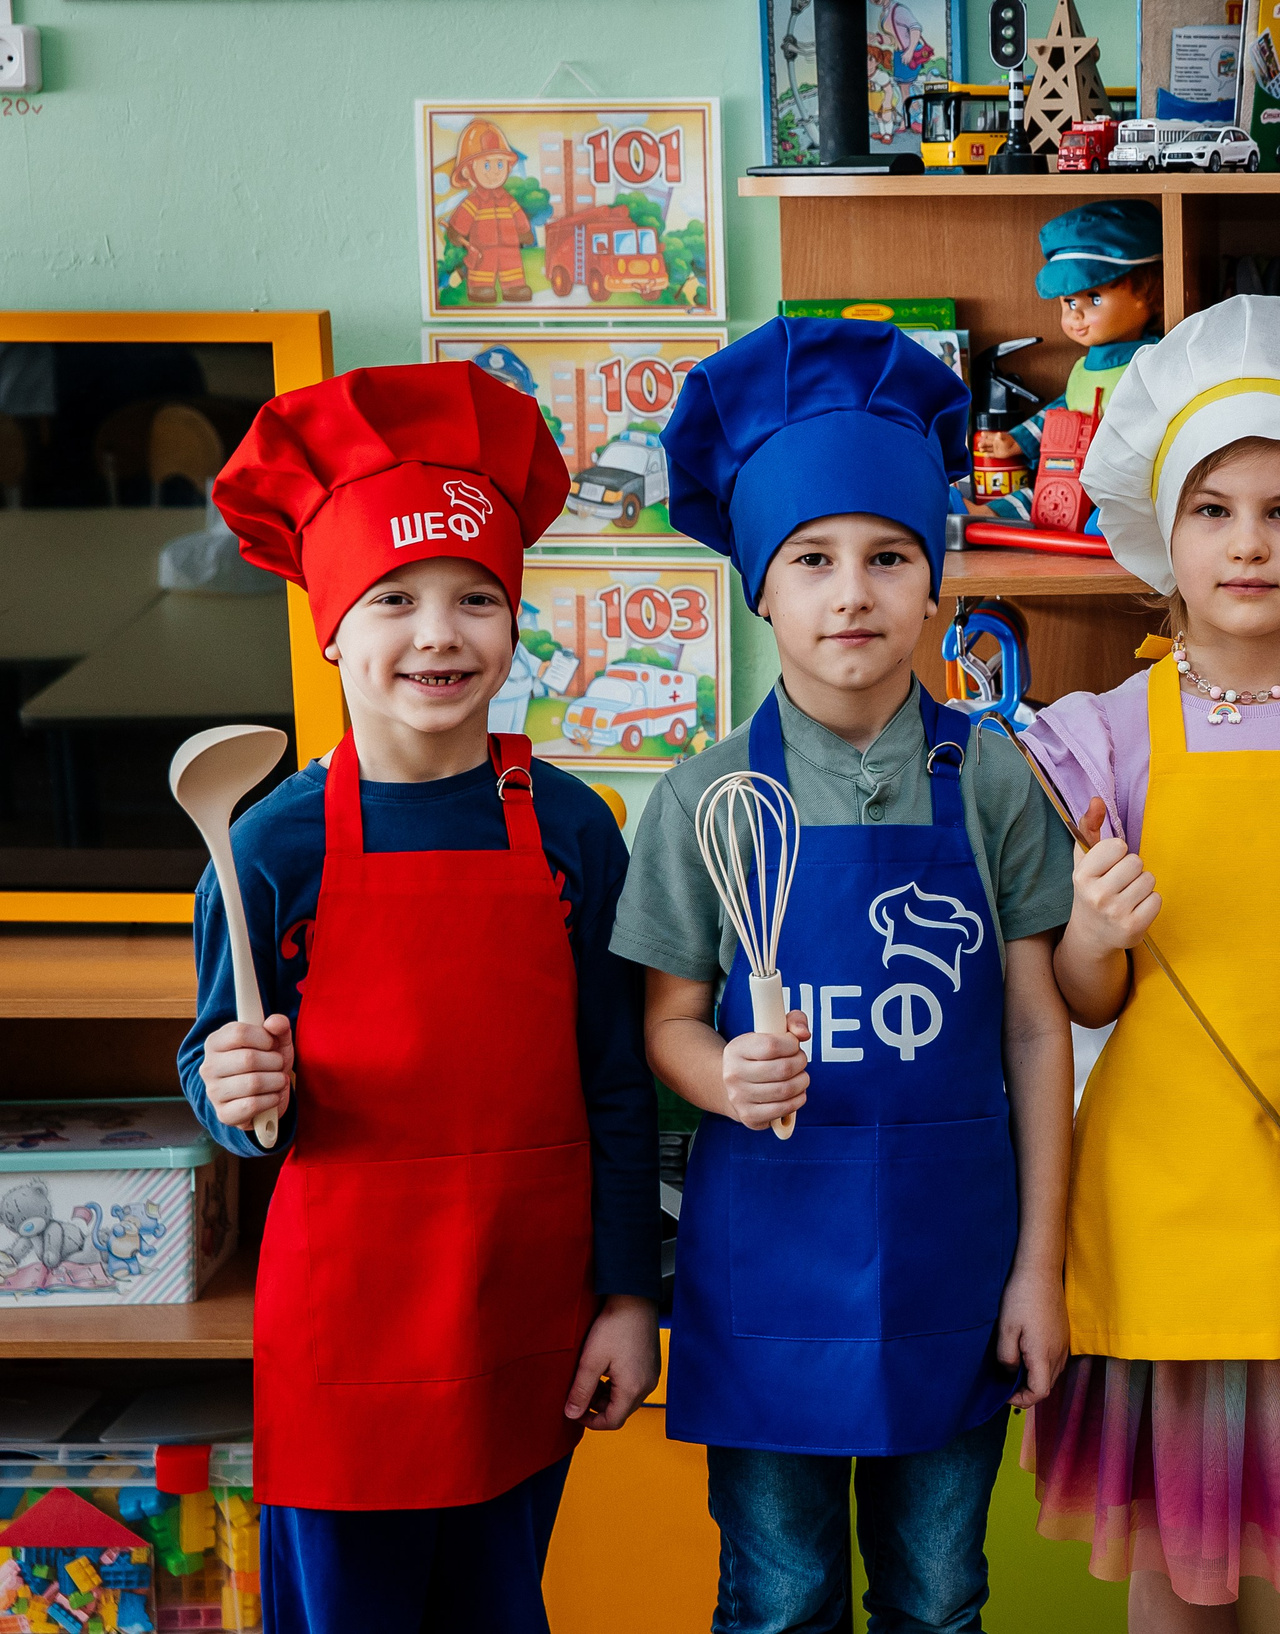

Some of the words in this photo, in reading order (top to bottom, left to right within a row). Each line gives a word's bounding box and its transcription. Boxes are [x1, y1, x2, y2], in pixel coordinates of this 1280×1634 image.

[586, 128, 682, 184] 101
[390, 511, 480, 549] ШЕФ
[599, 586, 709, 640] 103
